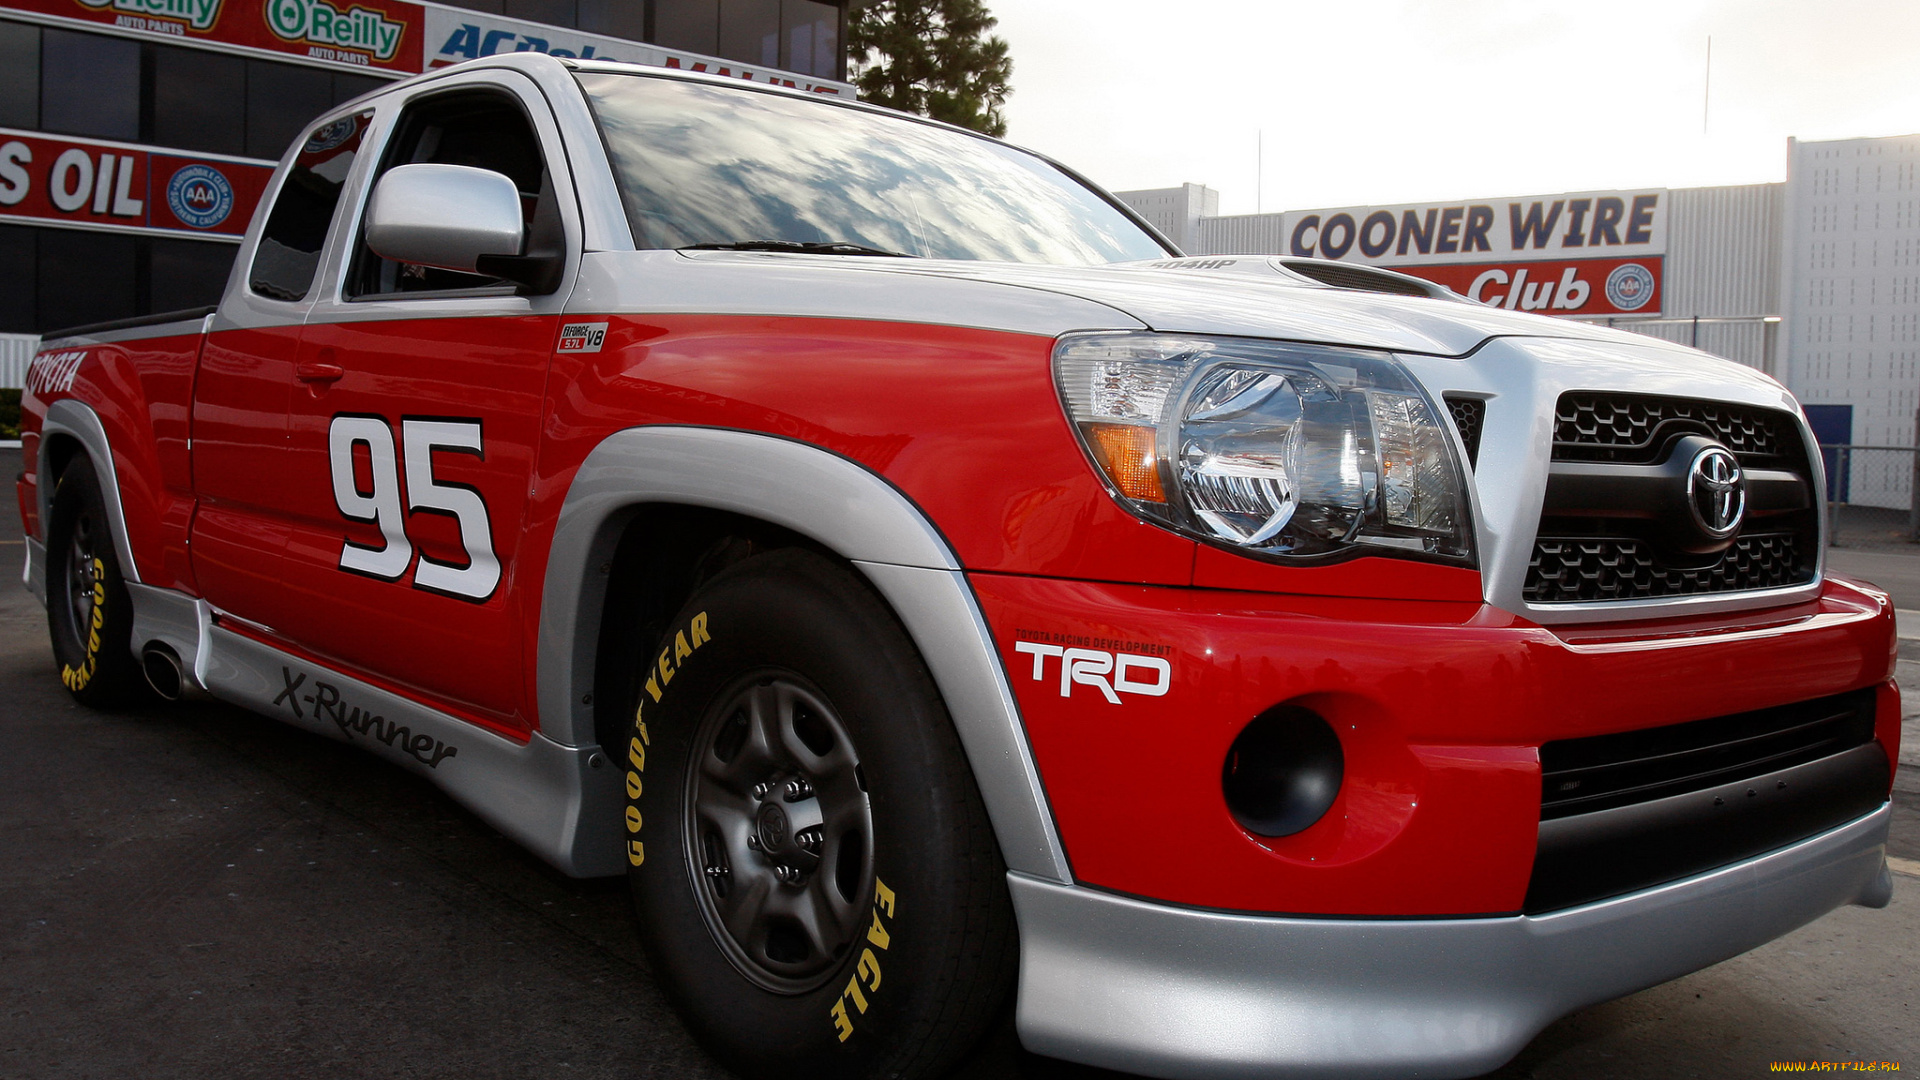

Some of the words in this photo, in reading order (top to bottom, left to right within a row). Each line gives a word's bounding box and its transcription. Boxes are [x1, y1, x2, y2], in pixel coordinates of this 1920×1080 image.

[115, 15, 146, 30] AUTO
[147, 19, 185, 35] PARTS
[308, 46, 335, 60] AUTO
[336, 50, 369, 65] PARTS
[50, 148, 144, 216] OIL
[186, 187, 215, 204] AAA
[1289, 205, 1495, 260] COONER
[1509, 193, 1660, 250] WIRE
[1467, 267, 1591, 311] Club
[587, 329, 605, 346] V8
[329, 411, 502, 605] 95
[1016, 628, 1051, 642] TOYOTA
[1053, 633, 1091, 647] RACING
[1093, 638, 1172, 656] DEVELOPMENT
[1015, 640, 1172, 705] TRD
[273, 666, 458, 769] X-Runner
[830, 875, 896, 1044] EAGLE
